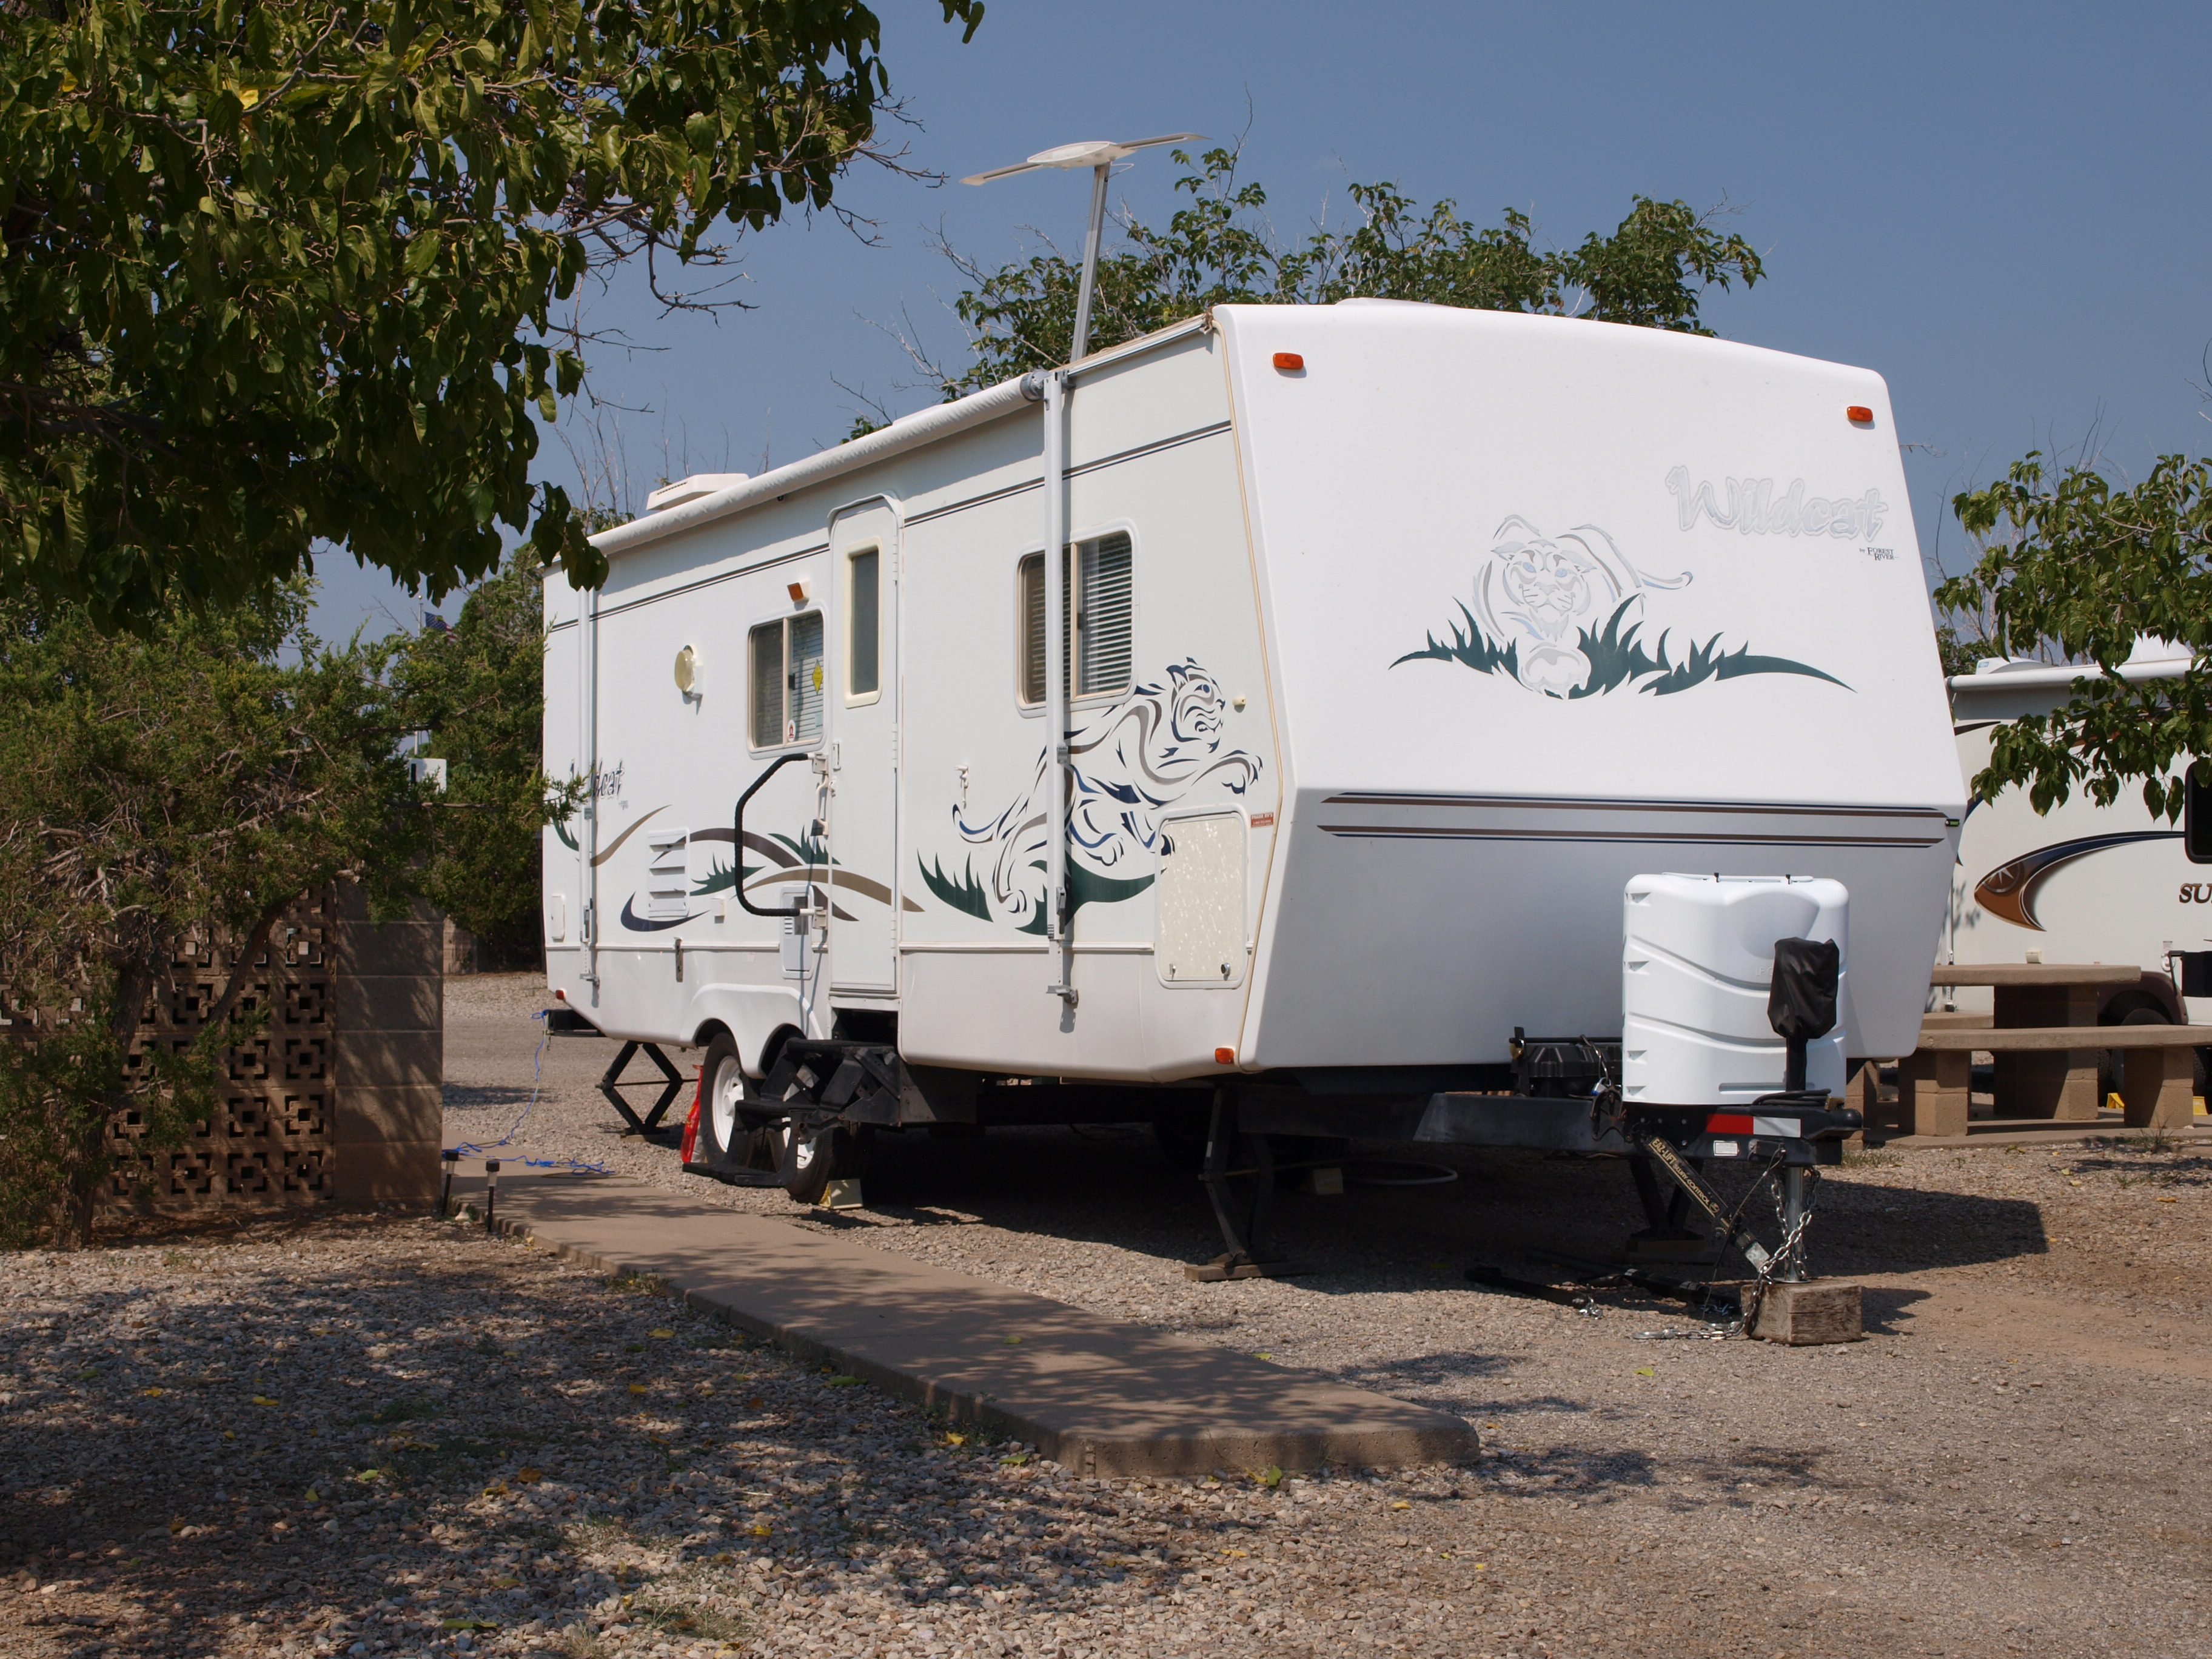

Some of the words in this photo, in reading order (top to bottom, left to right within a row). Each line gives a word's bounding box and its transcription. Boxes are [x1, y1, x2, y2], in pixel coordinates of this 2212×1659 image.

[1666, 466, 1888, 541] Wildcat
[2179, 883, 2212, 903] SU
[1652, 1138, 1678, 1164] EAZ-LIFT
[1672, 1163, 1689, 1179] SWAY
[1686, 1178, 1711, 1205] CONTROL
